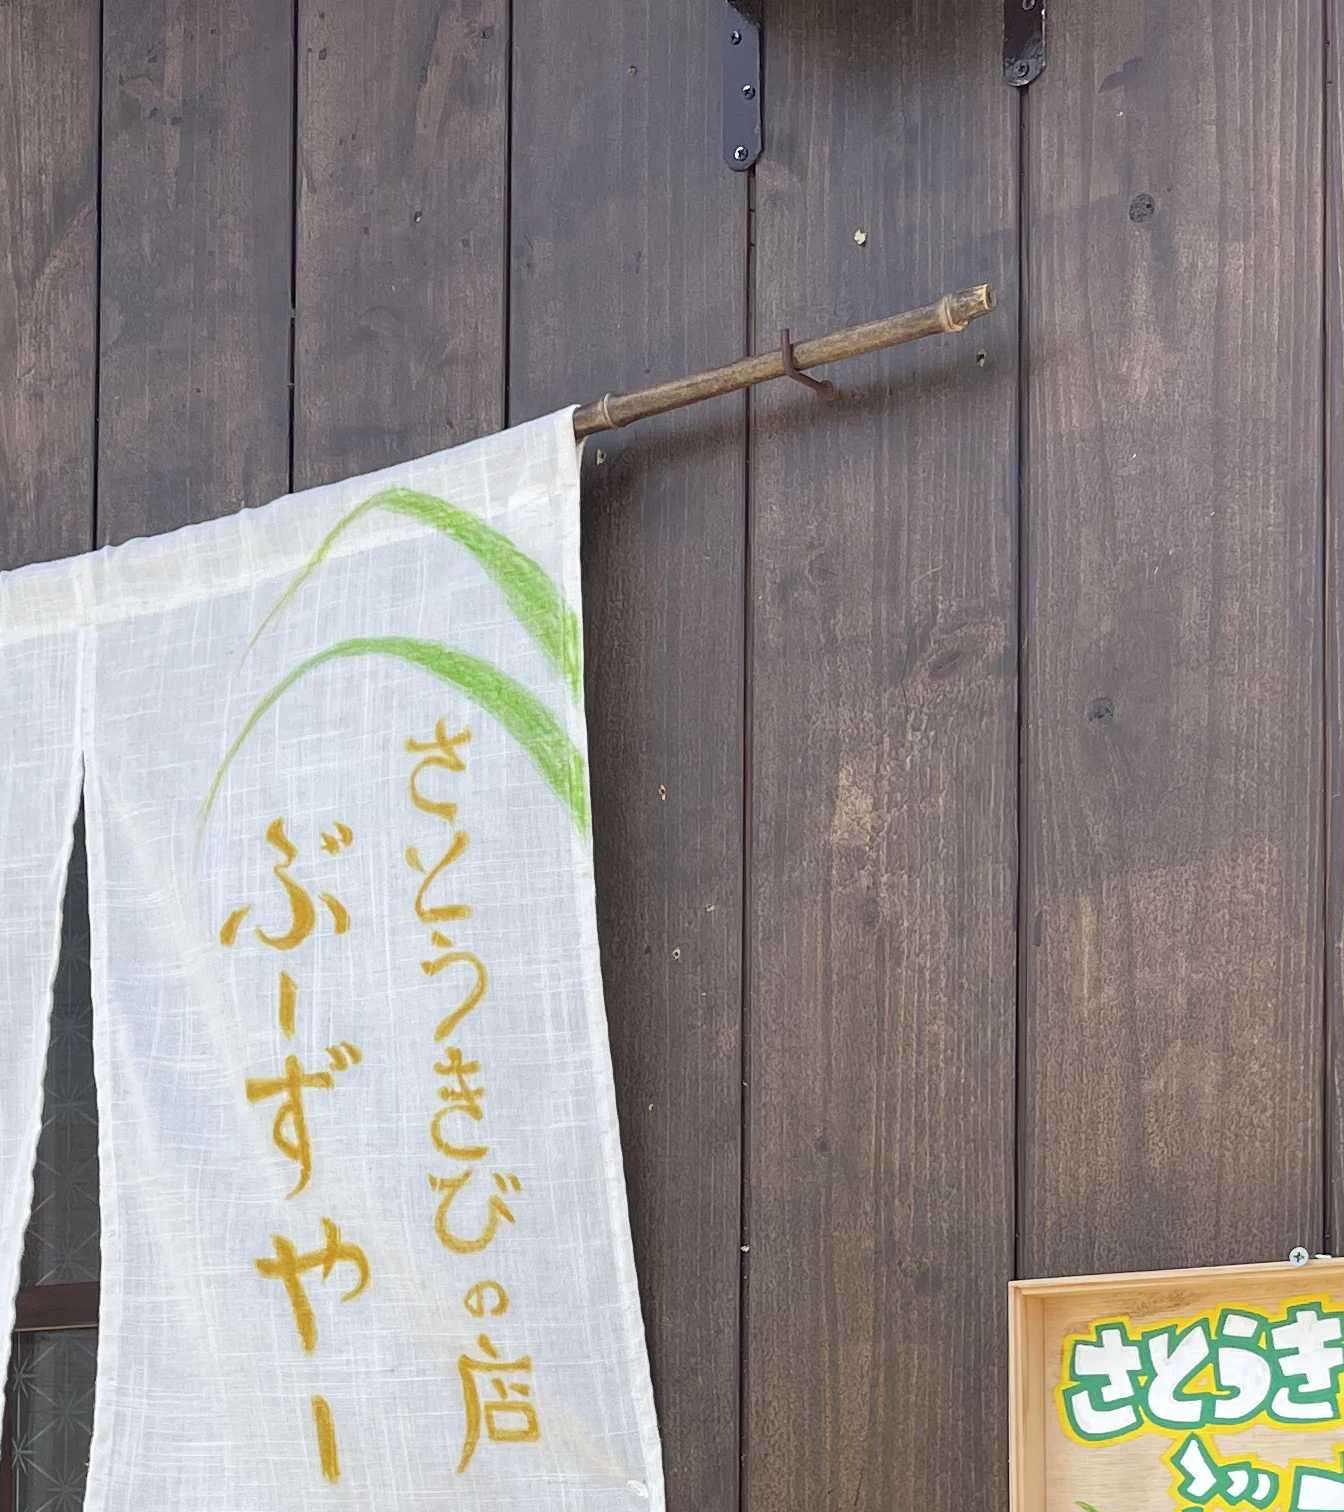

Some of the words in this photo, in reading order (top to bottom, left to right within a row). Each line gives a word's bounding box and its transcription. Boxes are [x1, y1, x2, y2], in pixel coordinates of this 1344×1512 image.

[220, 816, 371, 1484] ぶーずやー
[405, 717, 540, 1475] さとうきびの店
